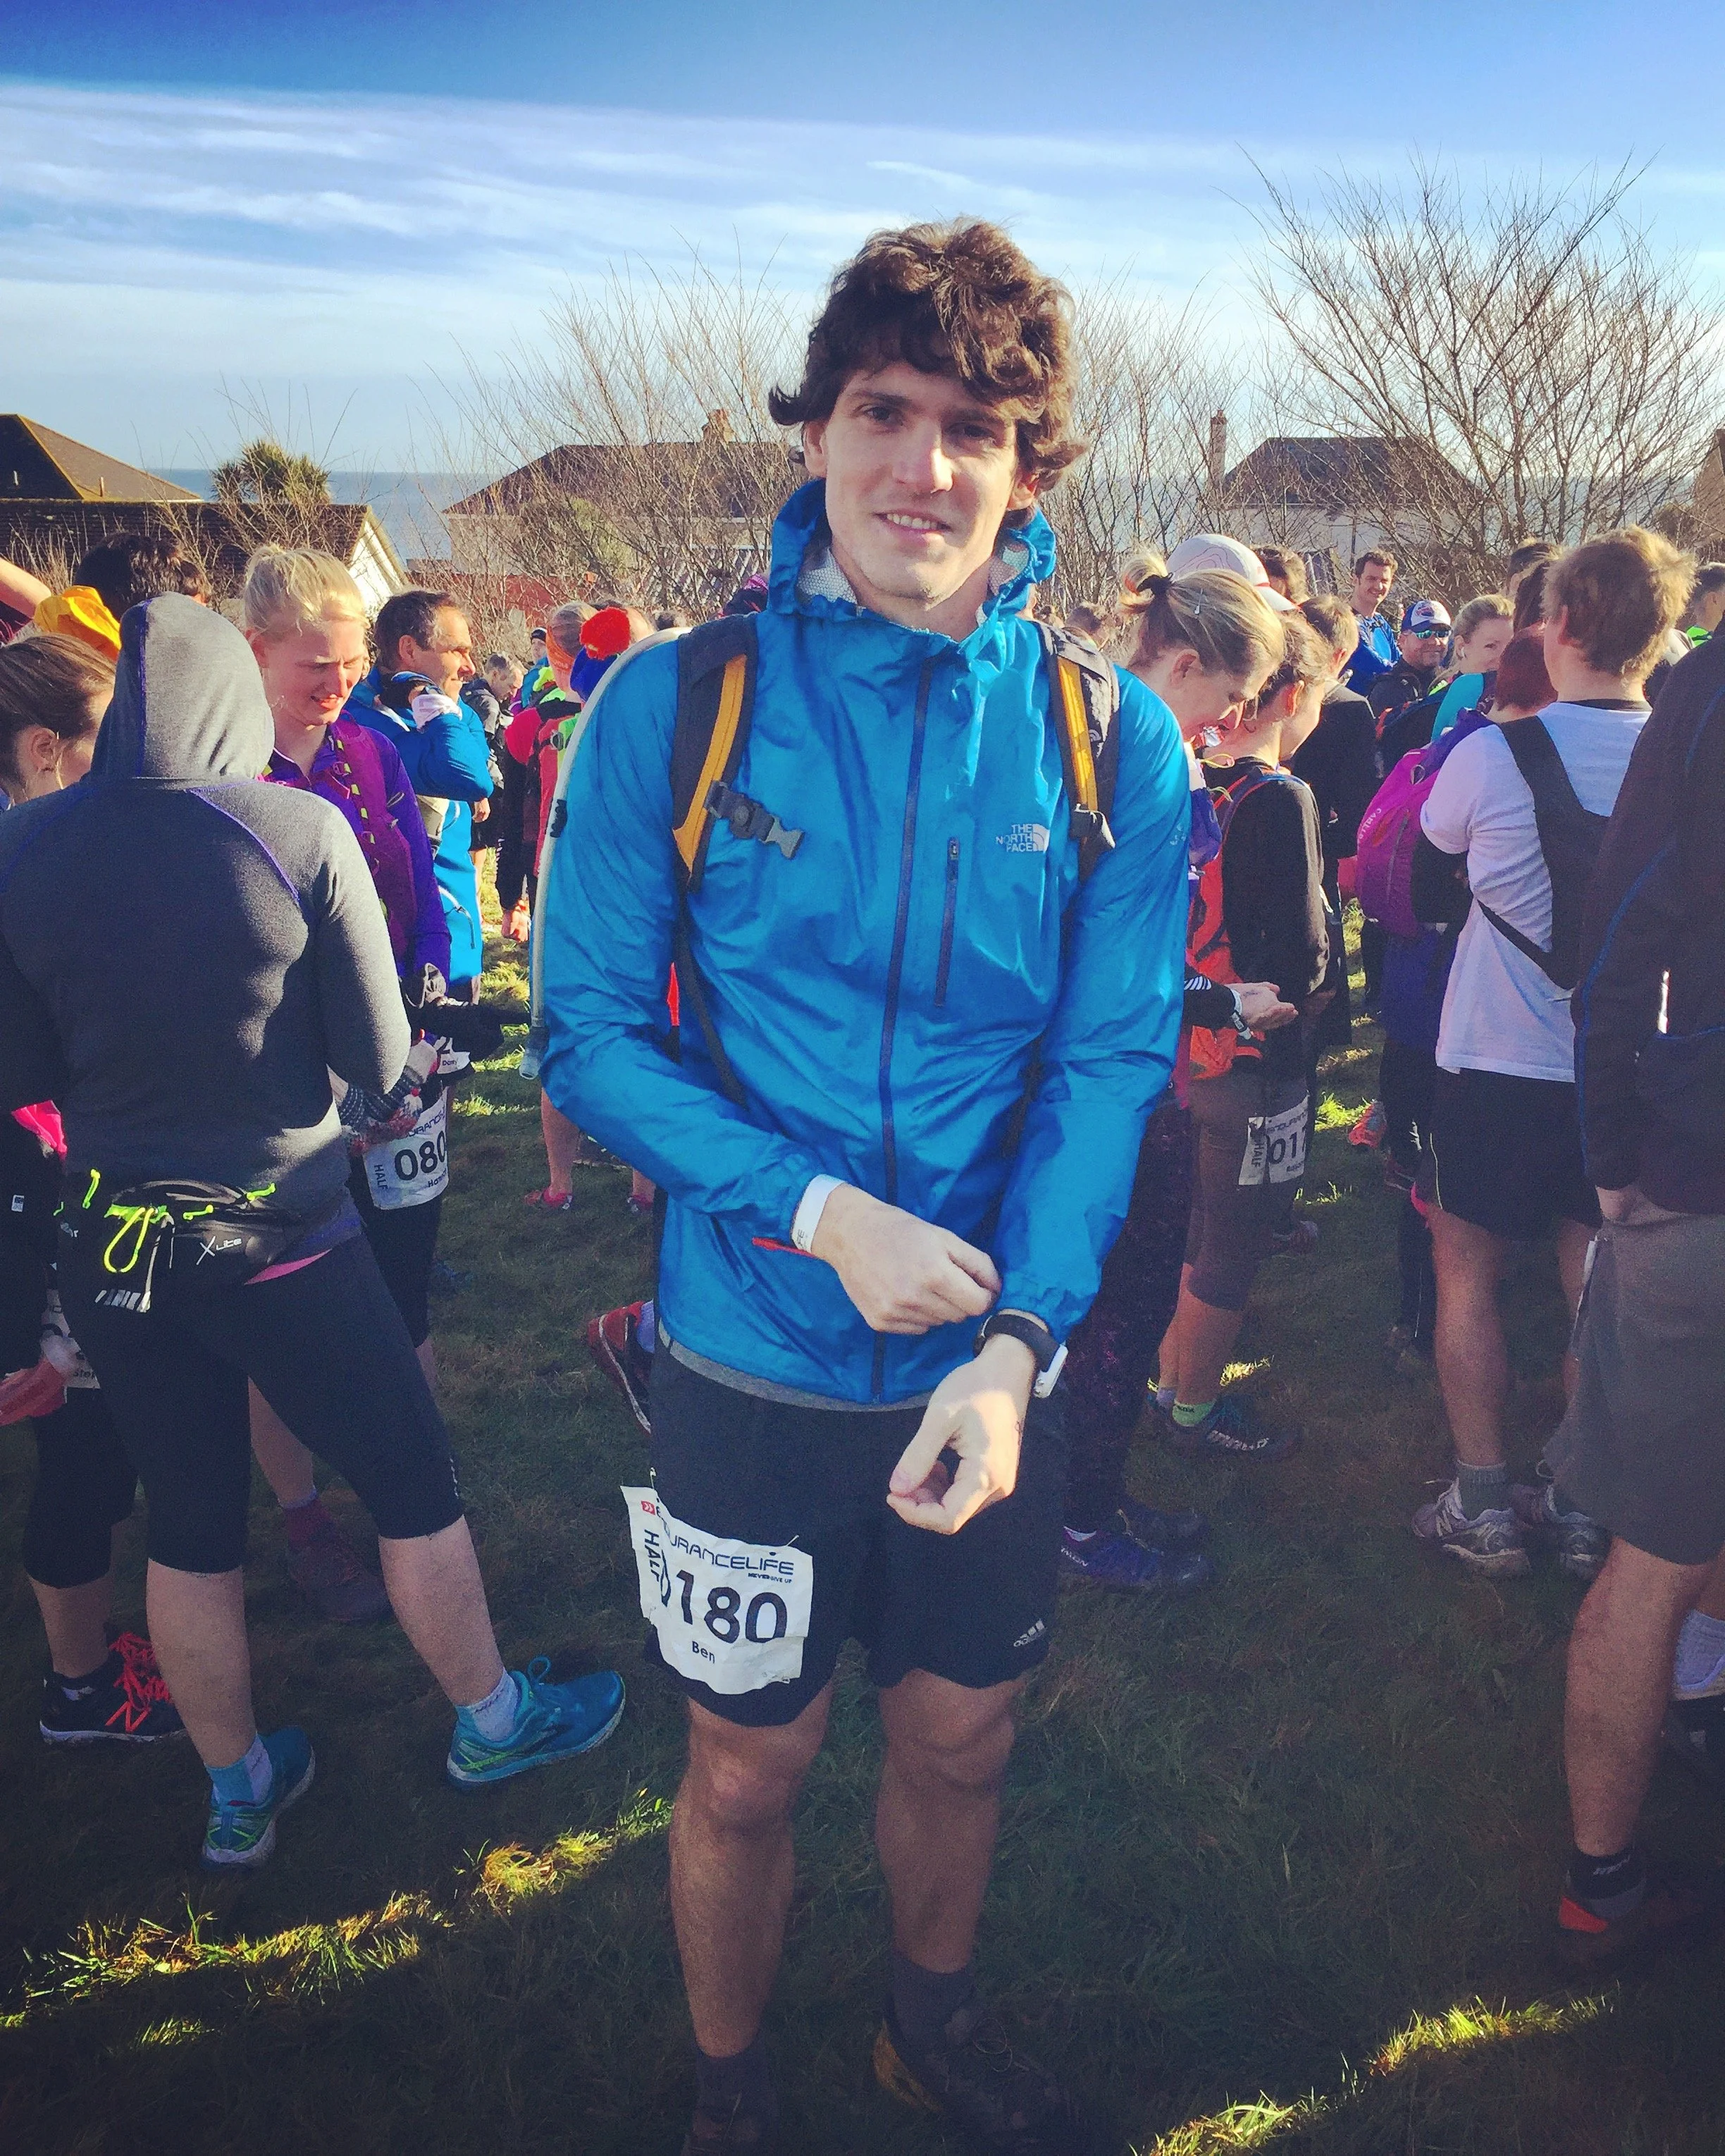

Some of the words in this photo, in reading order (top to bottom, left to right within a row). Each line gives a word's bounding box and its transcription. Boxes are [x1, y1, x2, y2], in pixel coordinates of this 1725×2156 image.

[995, 833, 1032, 844] NORTH
[1011, 823, 1032, 833] THE
[1006, 842, 1032, 852] FACE
[1251, 1144, 1265, 1168] HALF
[374, 1164, 388, 1190] HALF
[644, 1528, 661, 1582] HALF
[691, 1641, 715, 1663] Ben
